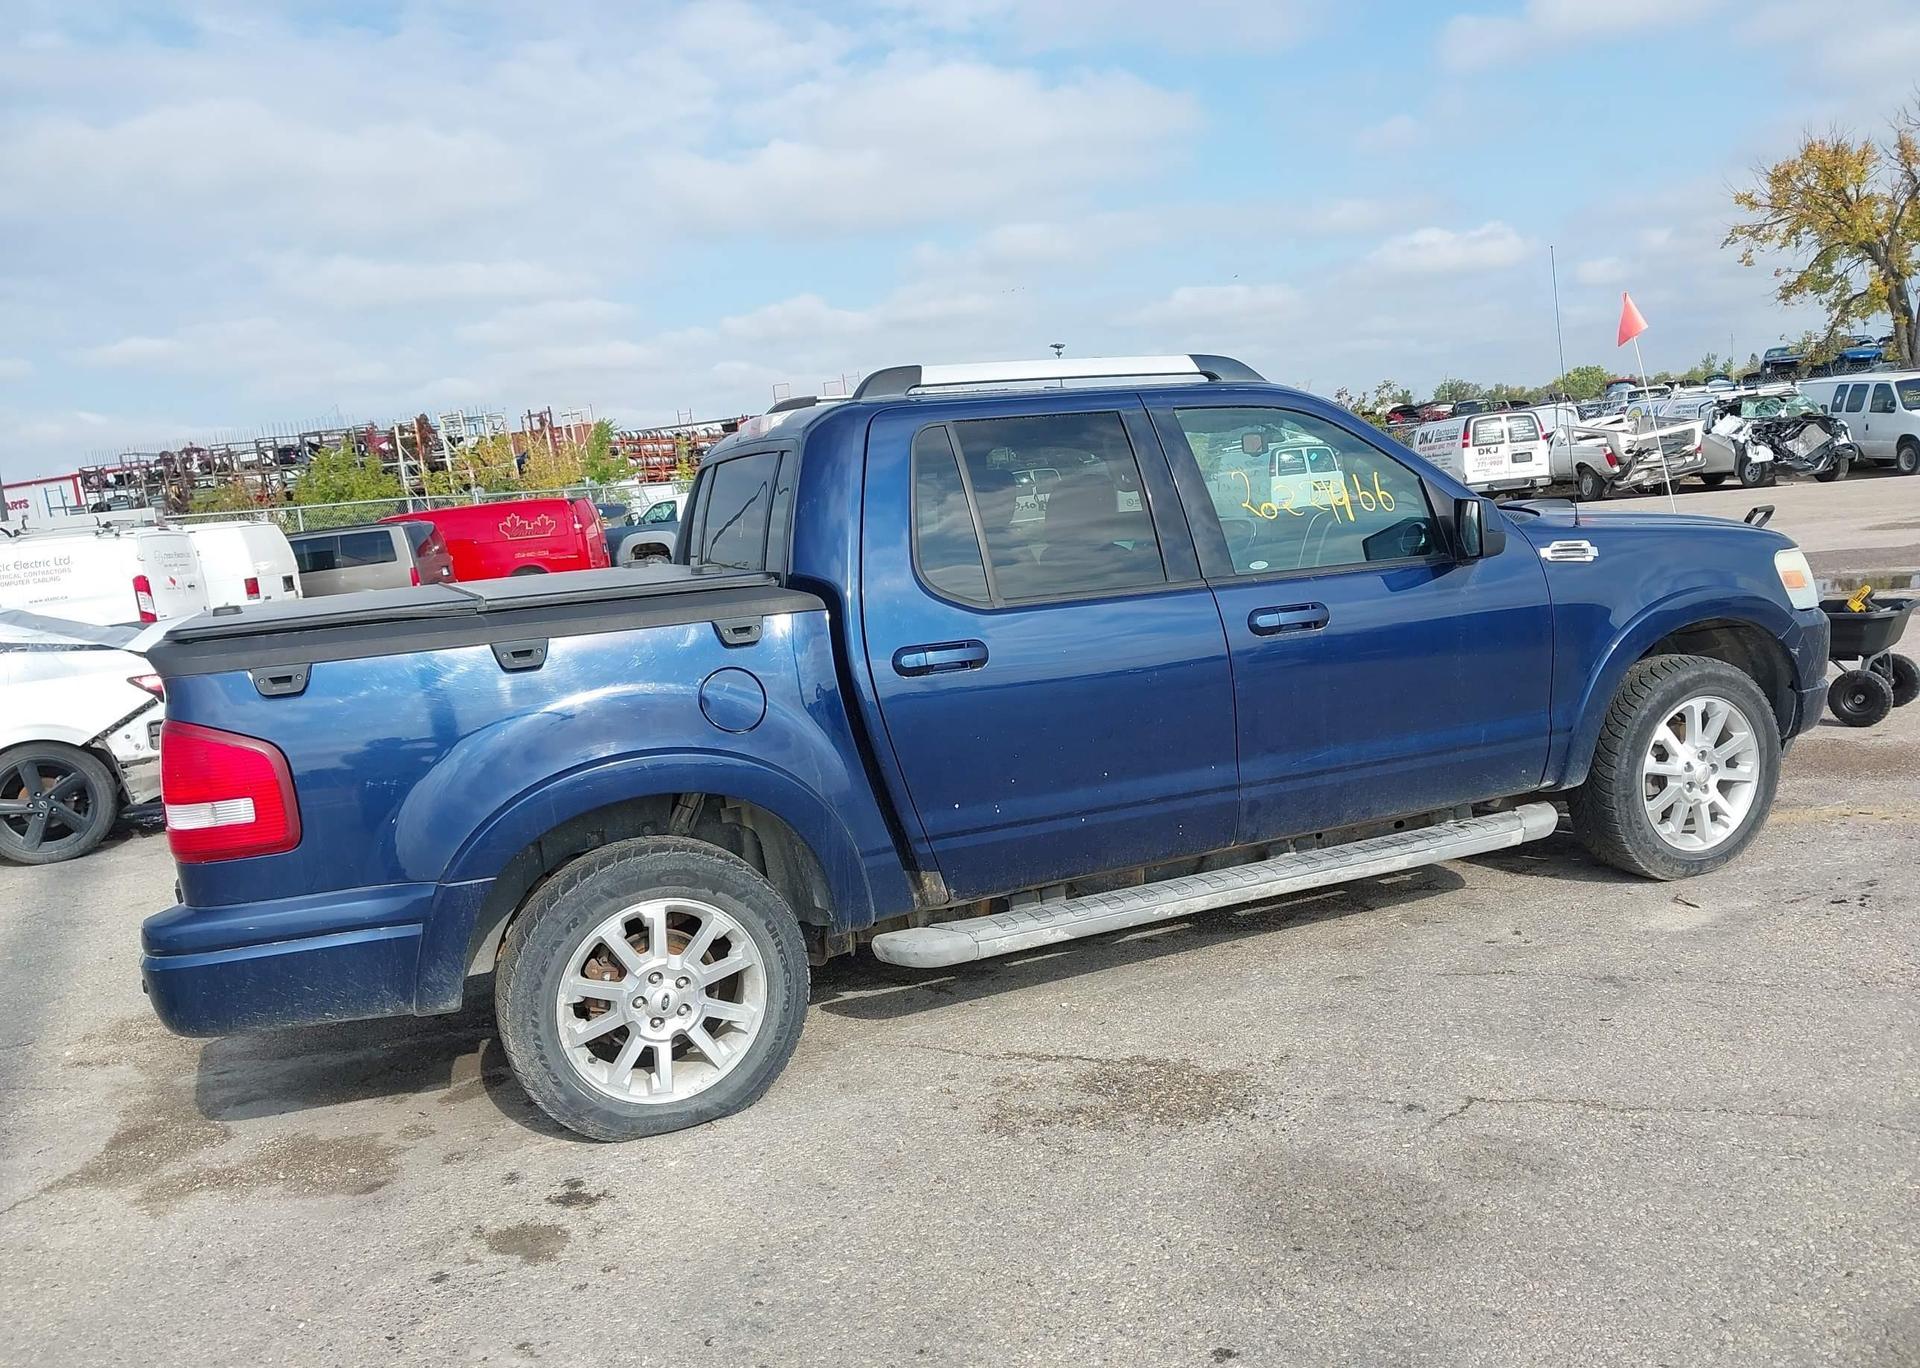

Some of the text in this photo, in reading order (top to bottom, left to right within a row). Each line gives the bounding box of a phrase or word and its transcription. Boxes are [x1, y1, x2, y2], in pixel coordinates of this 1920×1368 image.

[1418, 429, 1435, 446] DKJ
[1477, 446, 1499, 456] DKJ
[13, 559, 51, 571] Electric
